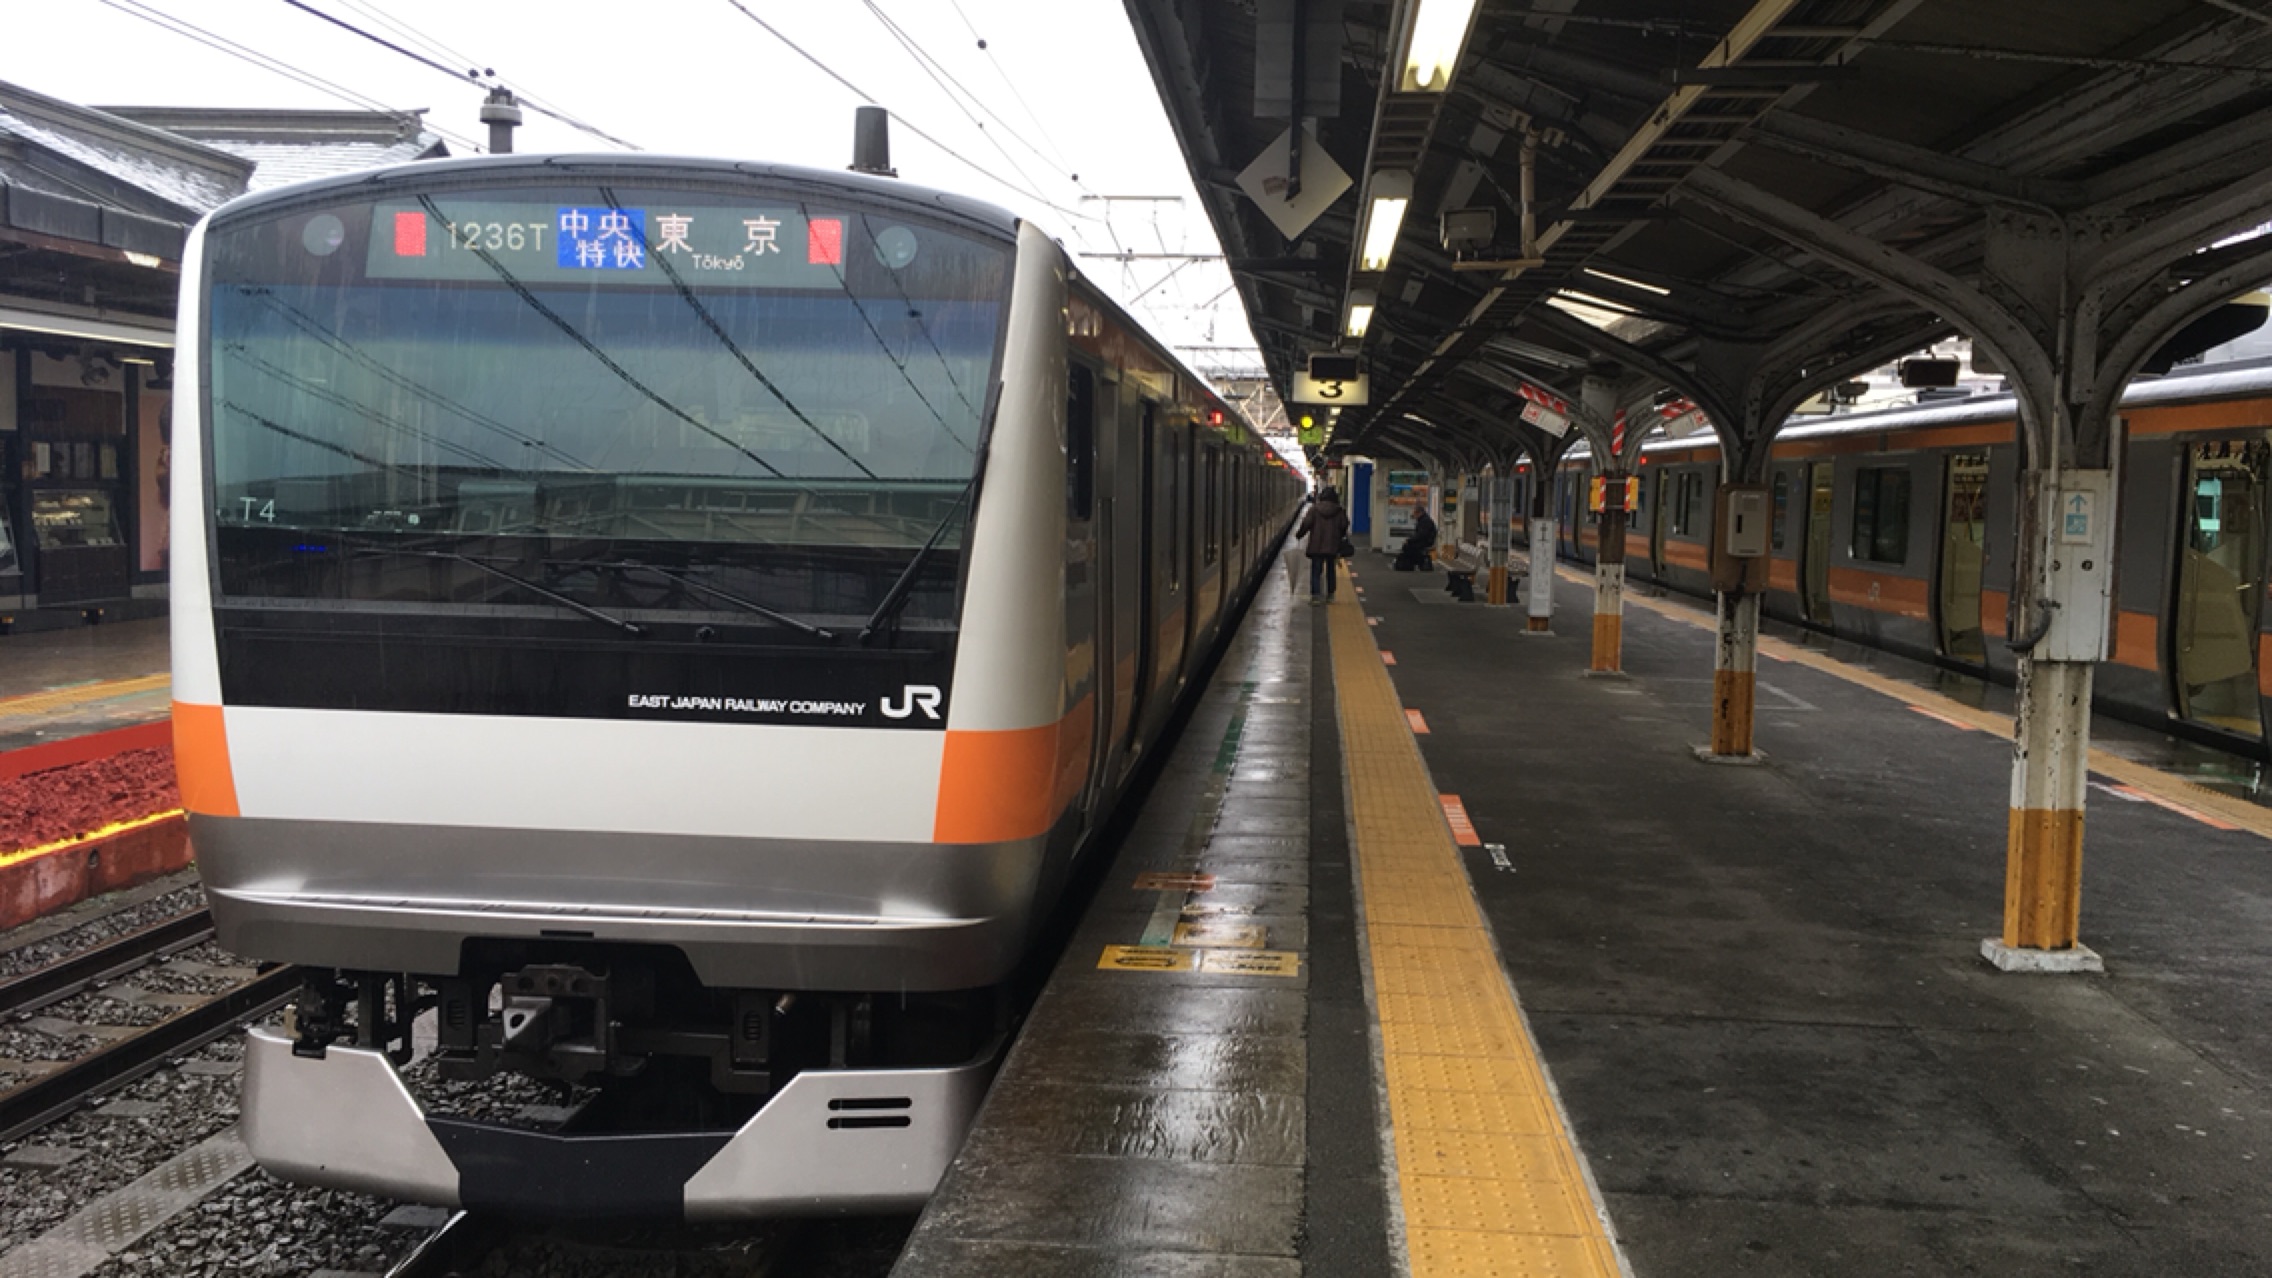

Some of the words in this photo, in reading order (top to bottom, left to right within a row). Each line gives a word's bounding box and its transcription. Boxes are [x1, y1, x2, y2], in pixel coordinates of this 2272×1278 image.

[446, 221, 549, 251] 1236T
[561, 209, 632, 240] 中央
[576, 239, 644, 268] 特快
[1318, 380, 1343, 399] 3
[628, 694, 670, 708] EAST
[671, 696, 722, 710] JAPAN
[724, 697, 788, 713] RAILWAY
[789, 700, 866, 716] COMPANY
[880, 684, 942, 720] JR
